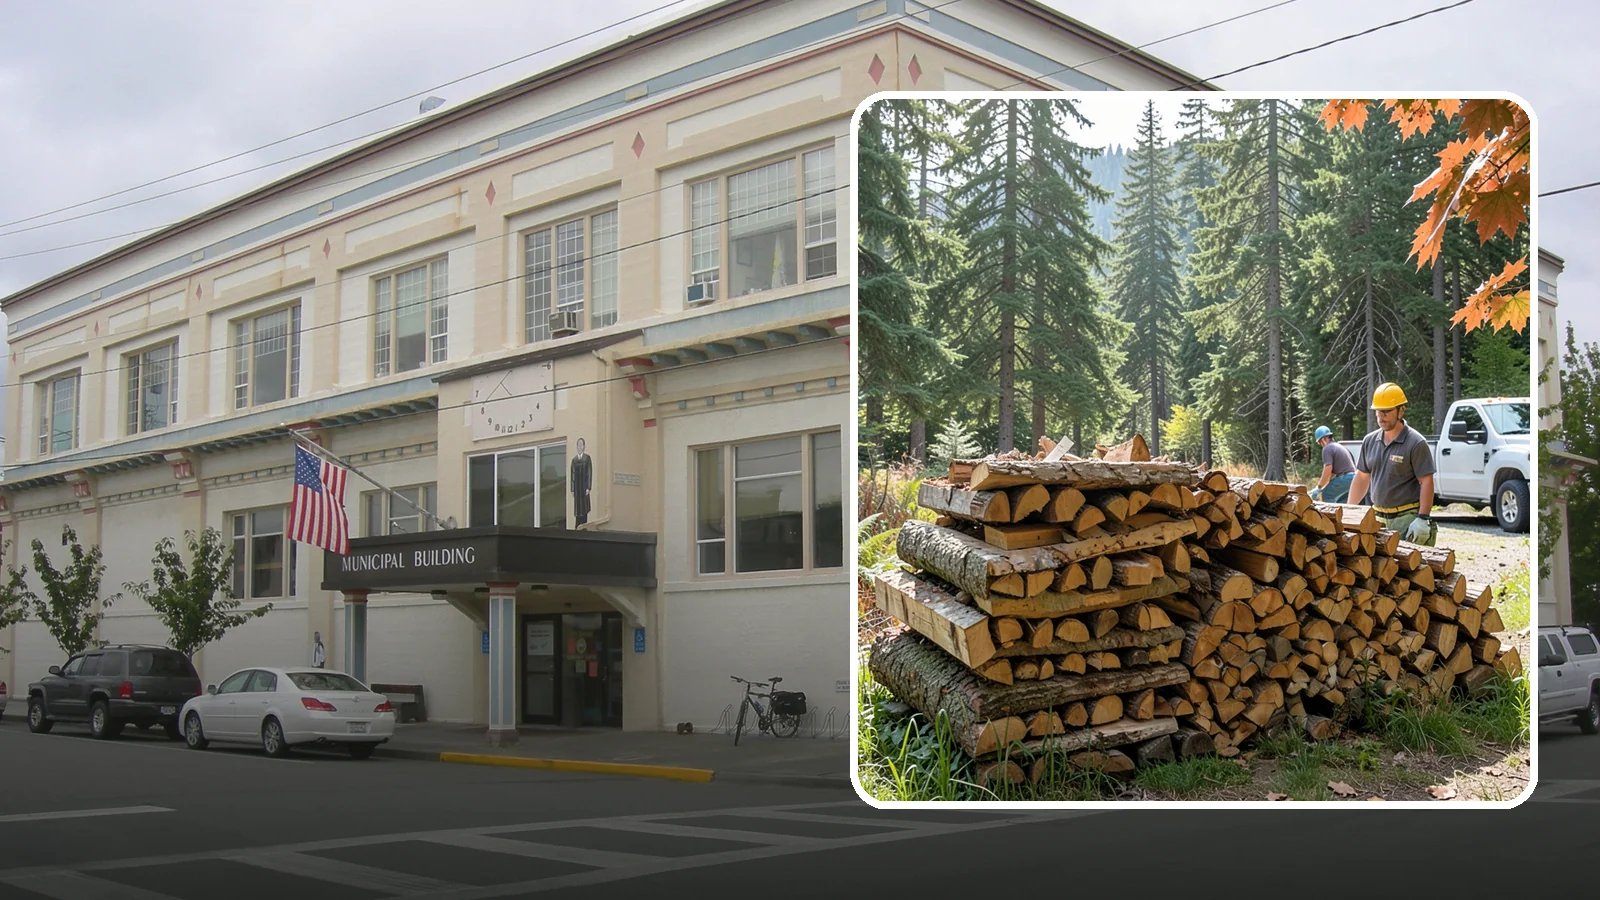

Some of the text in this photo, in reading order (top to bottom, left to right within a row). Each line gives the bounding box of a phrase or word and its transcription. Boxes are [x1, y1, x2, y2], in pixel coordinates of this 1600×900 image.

[475, 390, 479, 398] 7
[480, 406, 484, 415] 8
[488, 418, 492, 426] 9
[494, 423, 500, 432] 10
[507, 425, 513, 434] 12
[521, 420, 526, 428] 2
[528, 414, 532, 422] 3
[536, 402, 540, 410] 4
[342, 546, 475, 572] MUNICIPAL BUILDING
